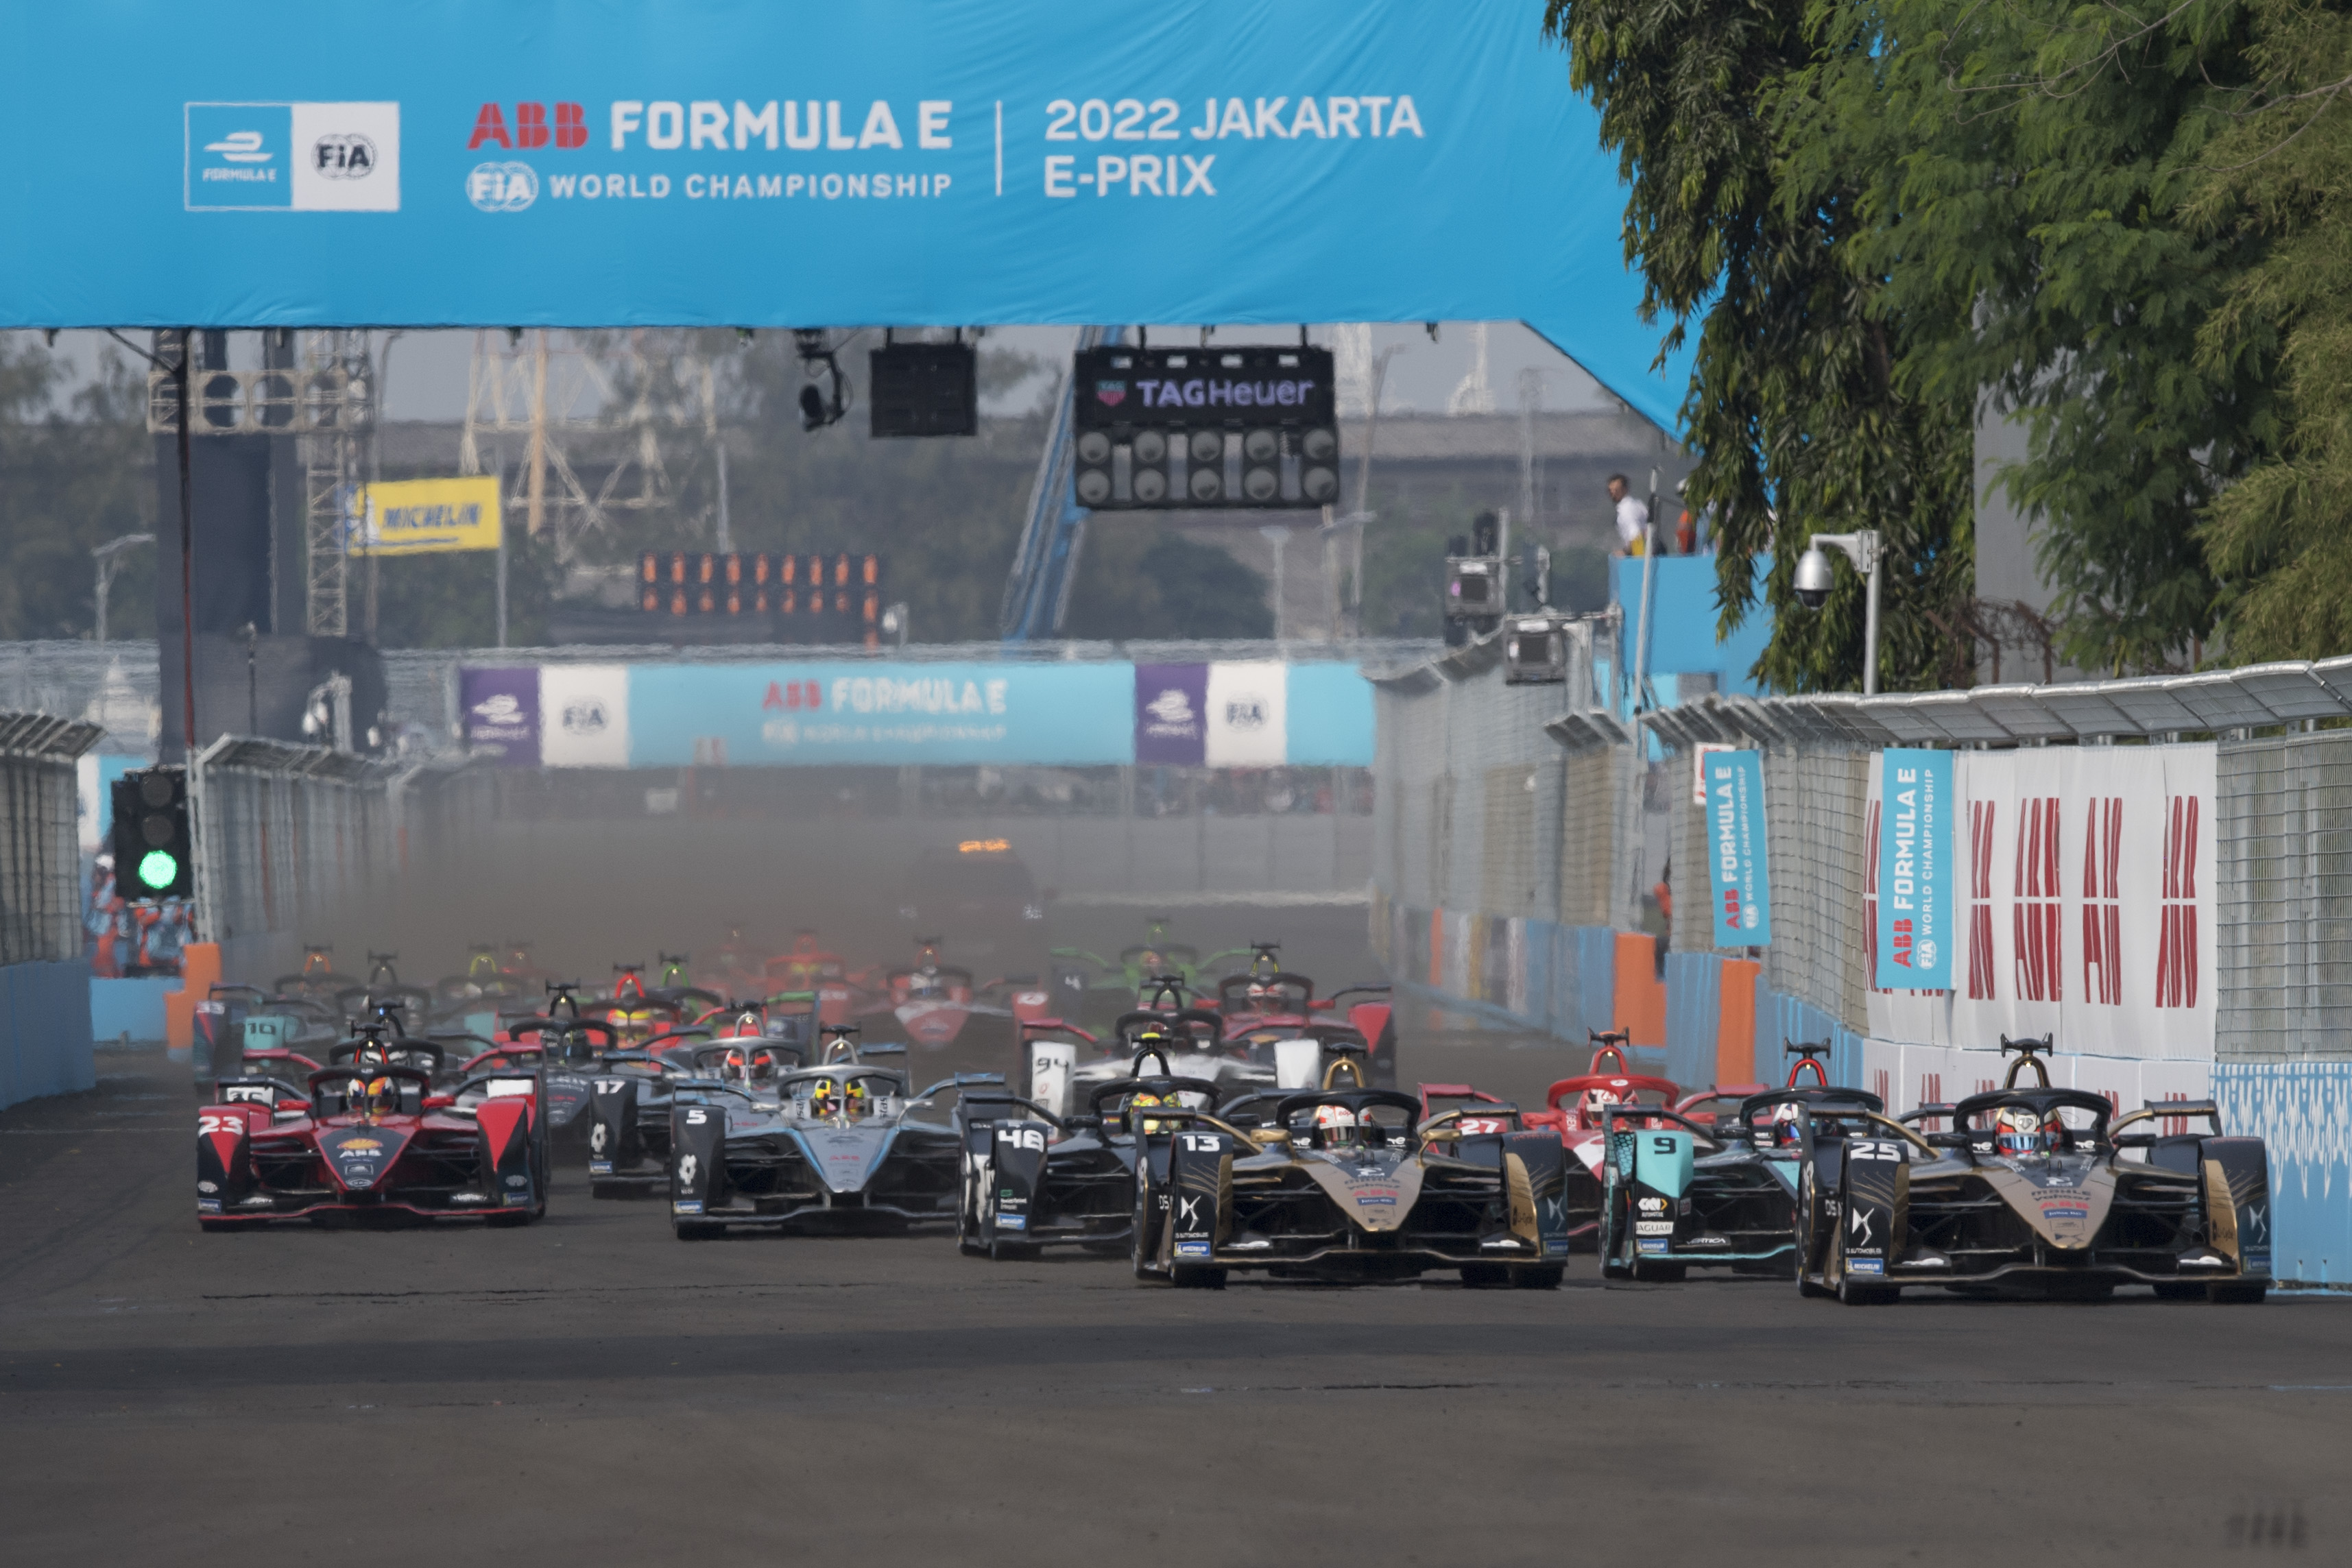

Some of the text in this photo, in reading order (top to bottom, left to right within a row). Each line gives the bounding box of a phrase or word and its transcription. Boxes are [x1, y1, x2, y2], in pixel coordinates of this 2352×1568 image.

[466, 100, 952, 150] ABB FORMULA E
[1044, 95, 1426, 141] 2022 JAKARTA
[317, 145, 370, 169] FIA
[202, 167, 276, 182] FORMULA E
[472, 173, 952, 200] FIA WORLD CHAMPIONSHIP
[1044, 155, 1218, 197] E-PRIX
[830, 677, 984, 714] FORMULA
[1738, 765, 1753, 856] CHAMPIONSHIP
[1921, 769, 1934, 881] CHAMPIONSHIP
[1716, 765, 1740, 930] ABB FORMULA E
[1743, 858, 1754, 902] WORLD
[1892, 767, 1917, 969] ABB FORMULA E
[1921, 884, 1933, 936] WORLD
[247, 1022, 277, 1035] 10
[1035, 1057, 1070, 1075] 94
[593, 1080, 626, 1094] 17
[198, 1115, 243, 1138] 23
[686, 1109, 708, 1124] 5
[1460, 1119, 1500, 1135] 27
[998, 1129, 1044, 1153] 48
[1182, 1135, 1221, 1152] 13
[1653, 1137, 1677, 1155] 9
[1850, 1142, 1901, 1162] 25
